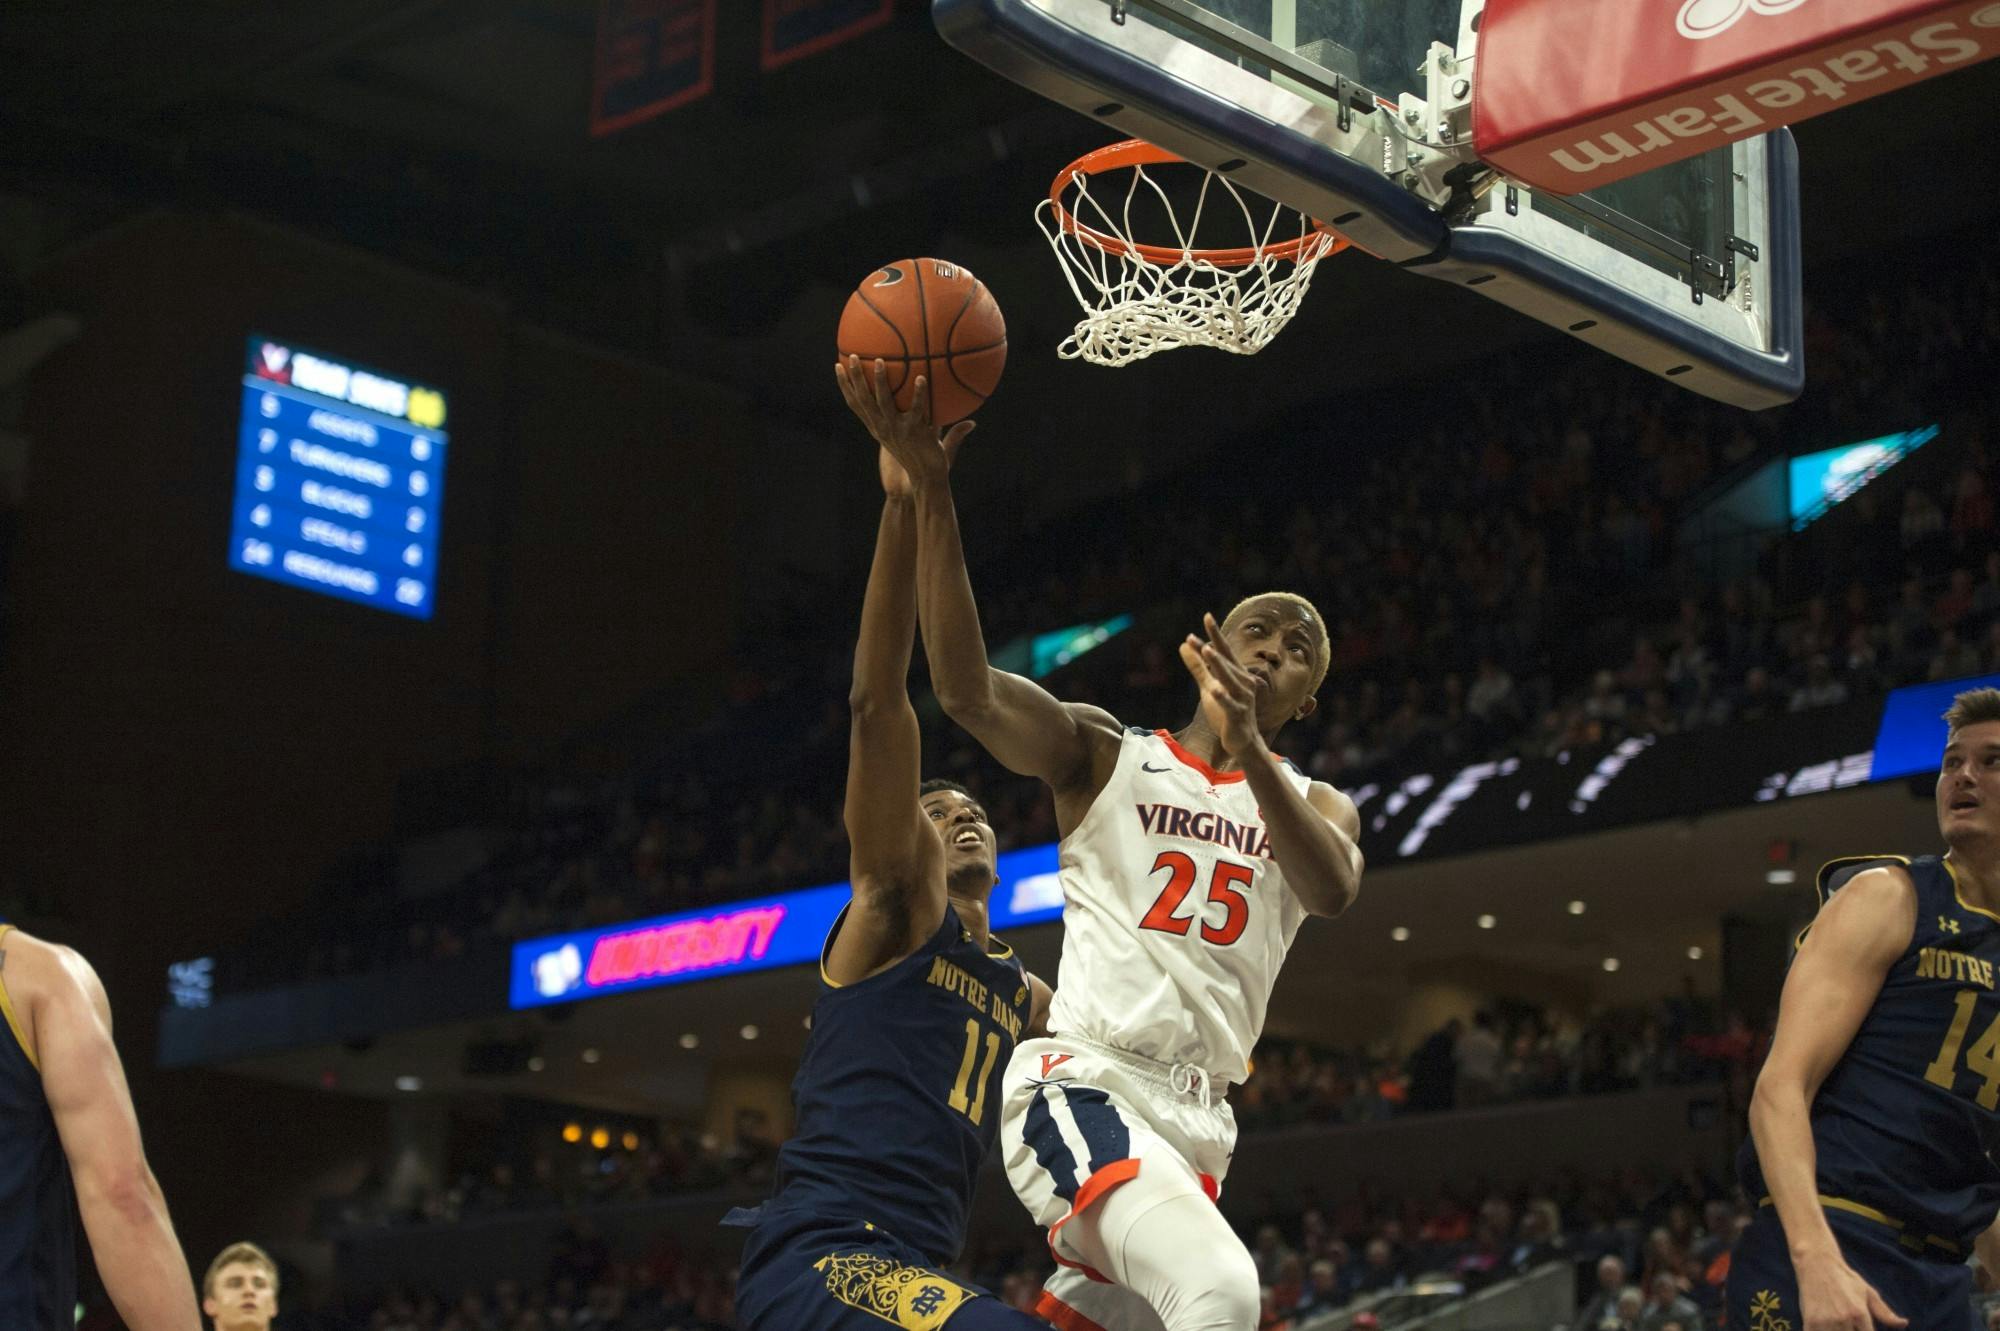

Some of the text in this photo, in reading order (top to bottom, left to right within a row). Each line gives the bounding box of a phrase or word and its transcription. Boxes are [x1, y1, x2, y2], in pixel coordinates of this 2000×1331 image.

[1135, 803, 1277, 862] VIRGINIA
[1138, 850, 1254, 946] 25
[926, 955, 989, 1014] NOTRE
[1915, 947, 1995, 990] NOTRE
[947, 1017, 1000, 1127] 11
[1923, 989, 2000, 1112] 14
